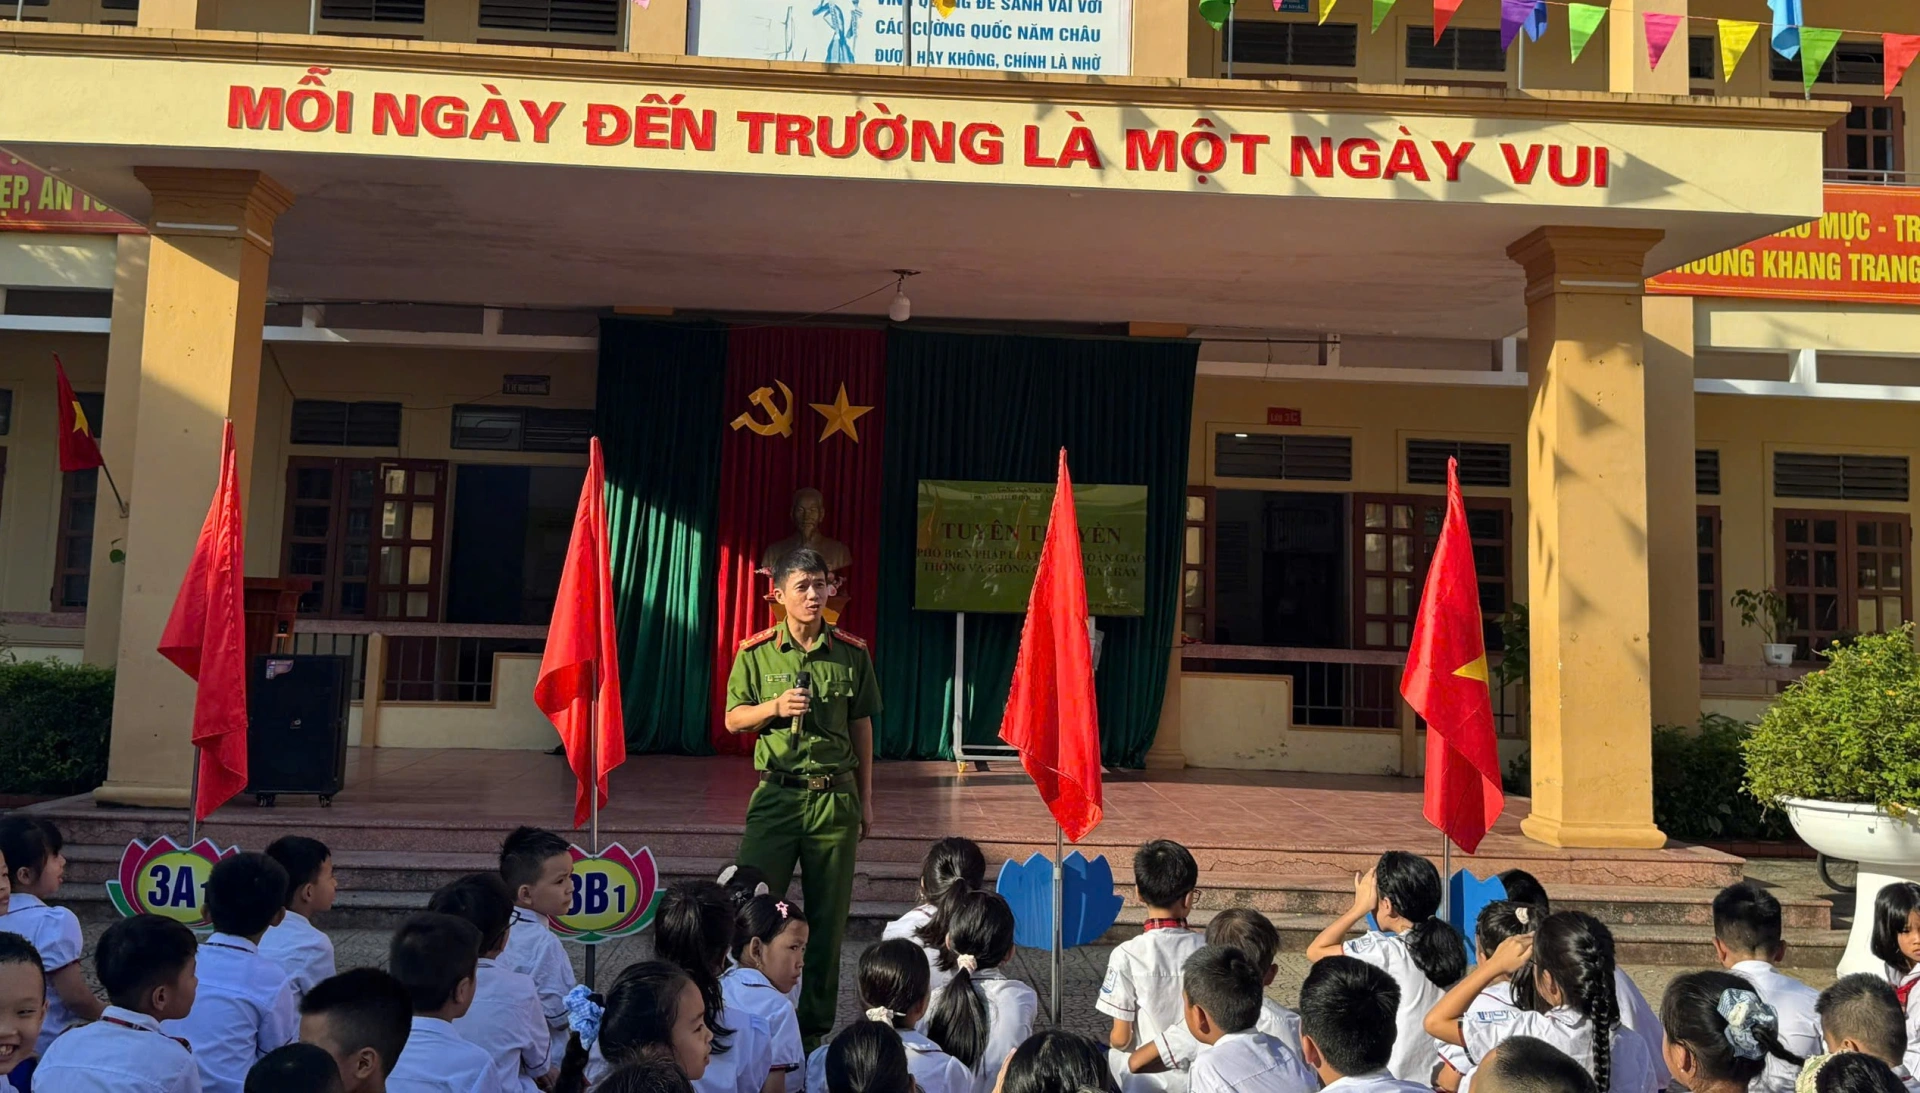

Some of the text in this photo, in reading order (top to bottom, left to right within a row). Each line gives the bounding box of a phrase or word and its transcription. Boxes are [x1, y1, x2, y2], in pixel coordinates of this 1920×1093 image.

[1049, 0, 1073, 13] VAI
[912, 18, 966, 38] CƯỜNG
[970, 20, 1013, 40] QUỐC
[1017, 22, 1054, 41] NĂM
[1058, 24, 1101, 43] CHÂU
[874, 47, 1102, 72] ĐƯỢ HAY KHÔNG, CHÍNH LÀ NHỜ
[228, 66, 1609, 187] MỖI NGÀY ĐẾN TRƯỜNG LÀ MỘT NGÀY VUI
[37, 176, 74, 211] AN
[1819, 210, 1871, 248] MỰC
[1762, 249, 1842, 281] KHANG
[1847, 252, 1920, 284] TRANG
[941, 519, 1122, 544] TUYÊN TYỀN
[1115, 553, 1147, 564] GIAO
